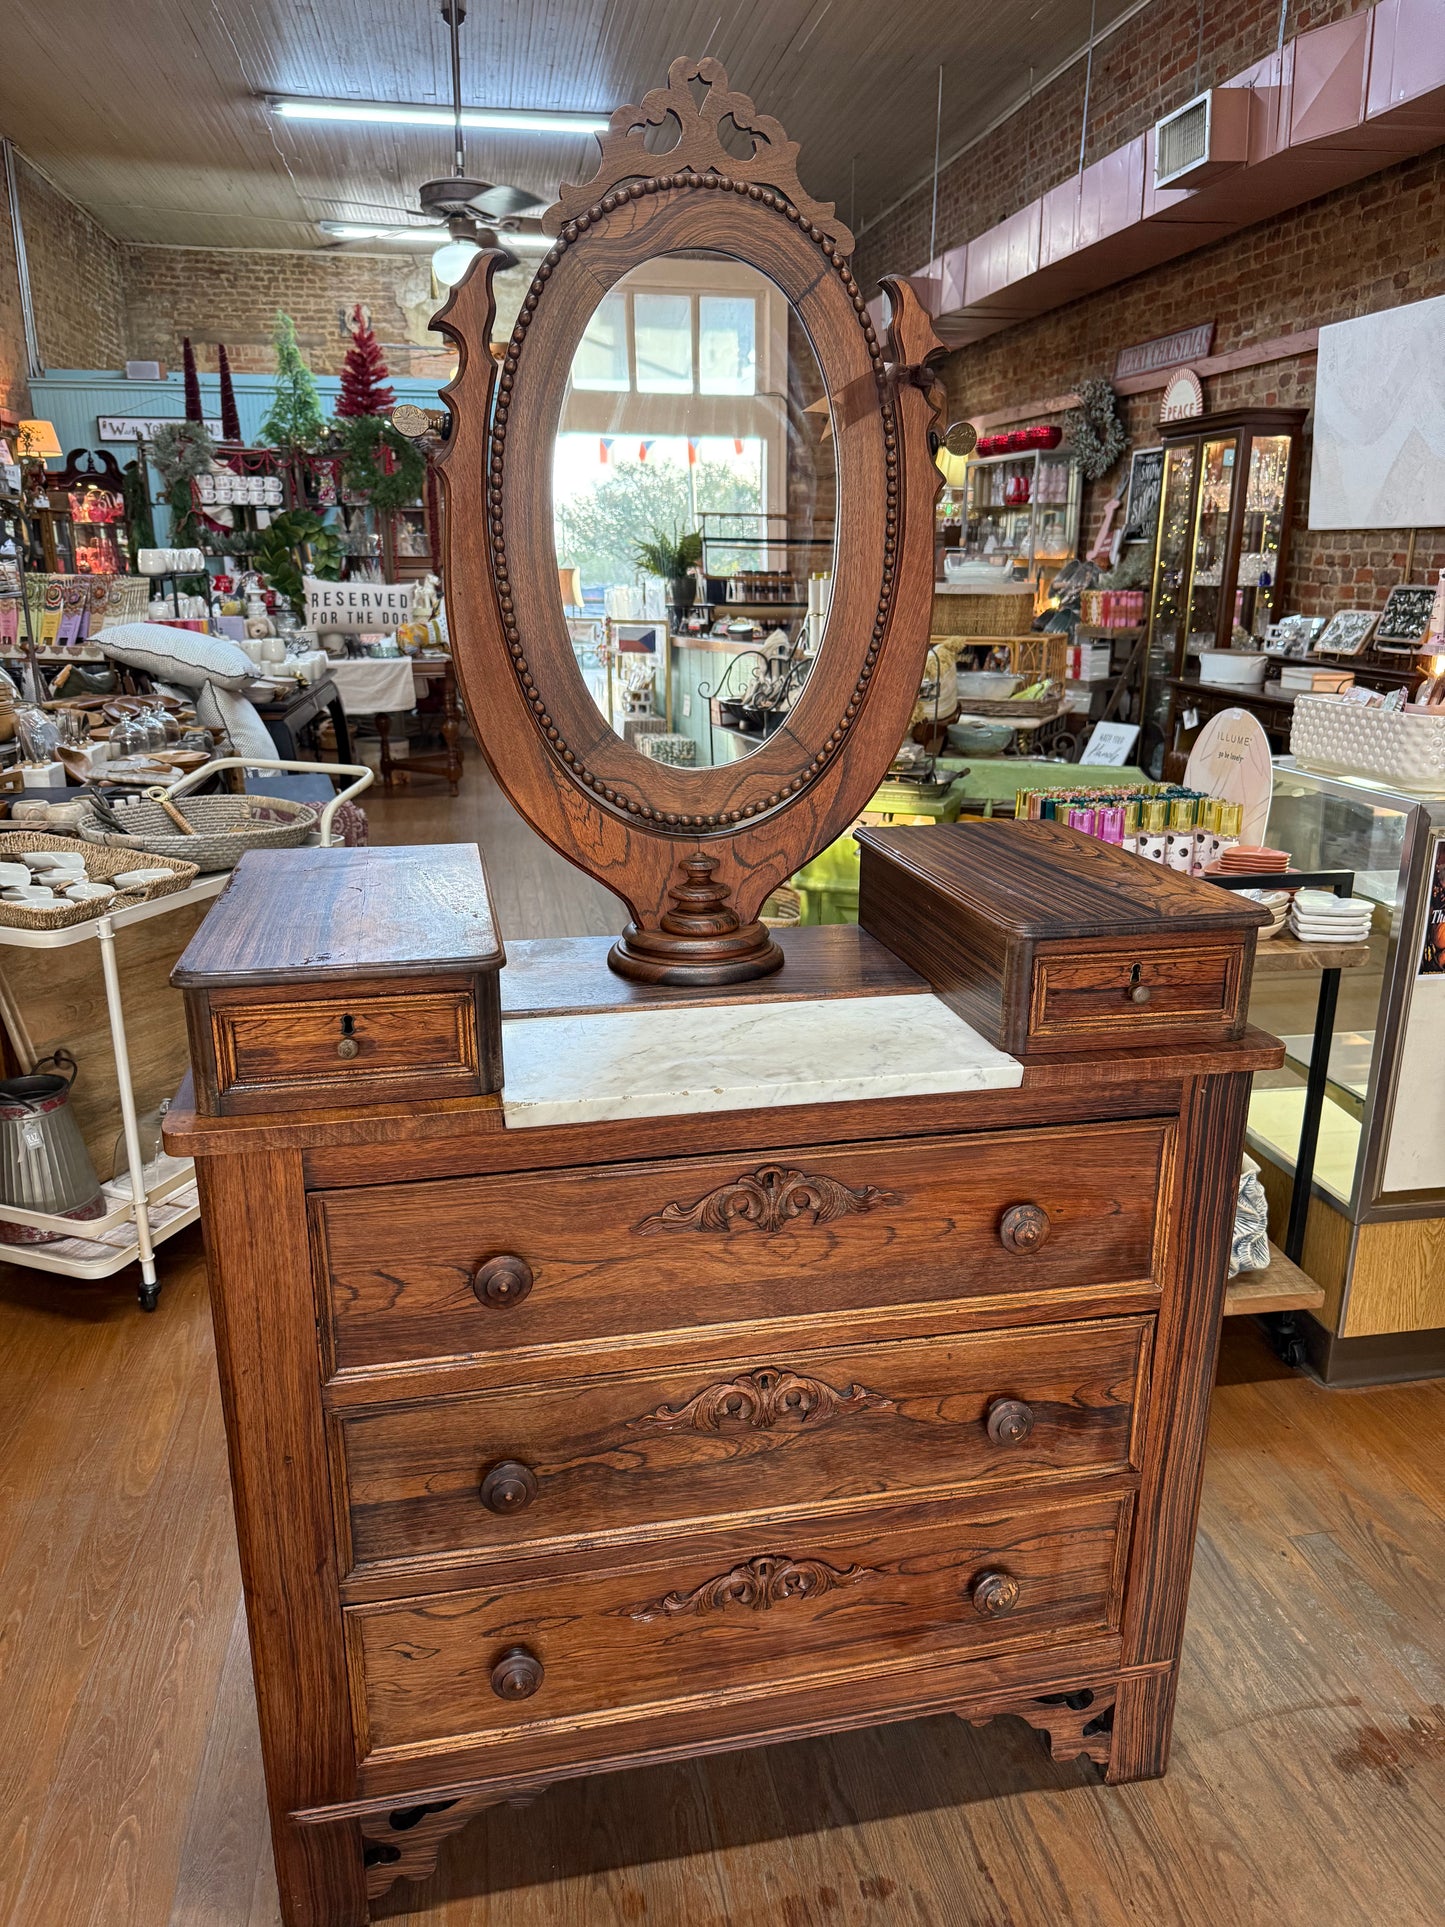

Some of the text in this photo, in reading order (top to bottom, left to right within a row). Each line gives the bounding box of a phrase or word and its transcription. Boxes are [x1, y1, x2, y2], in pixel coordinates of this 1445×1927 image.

[1167, 402, 1195, 420] PEACE
[311, 591, 408, 609] RESERVED
[312, 612, 409, 625] FOR THE DOG
